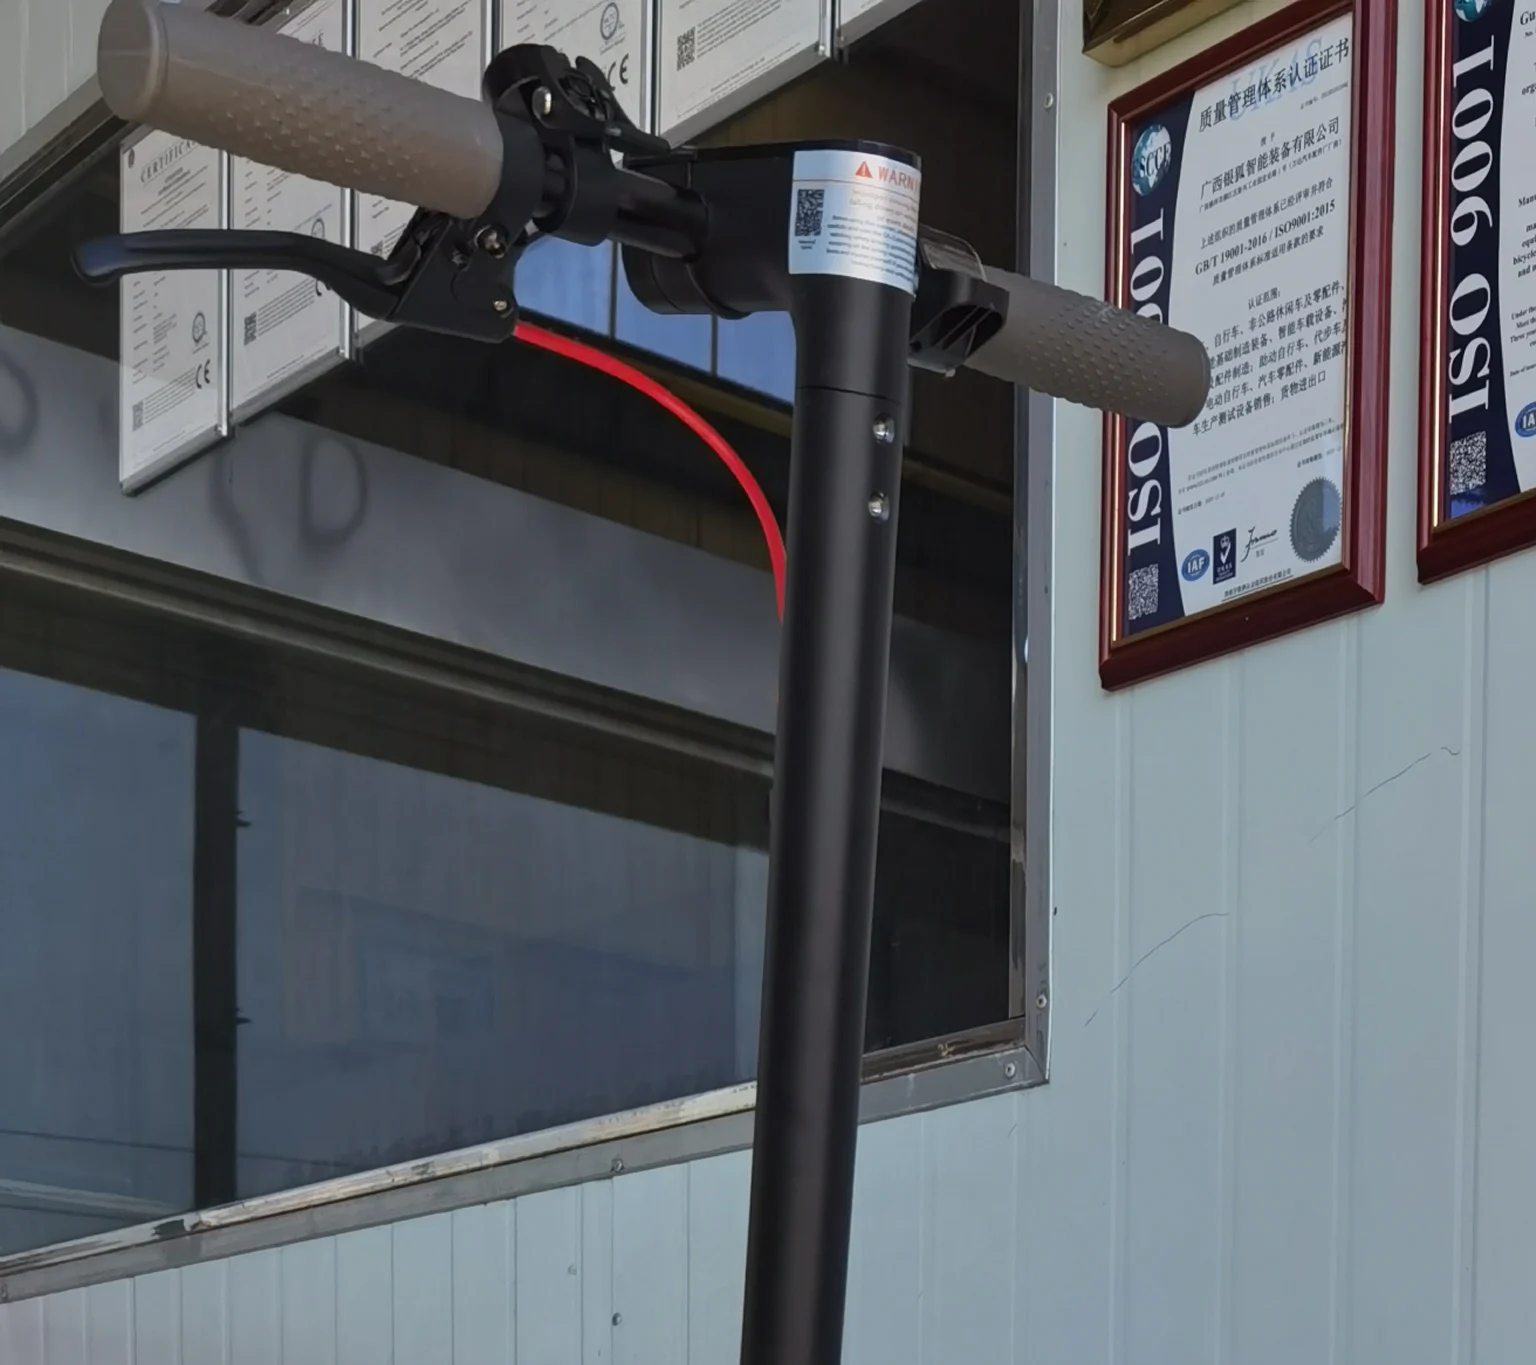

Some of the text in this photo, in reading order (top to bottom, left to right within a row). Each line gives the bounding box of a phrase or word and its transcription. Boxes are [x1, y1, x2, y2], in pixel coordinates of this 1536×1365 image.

[1199, 38, 1349, 132] 质量管理体系认证证书
[141, 140, 196, 183] CERTIFICA
[1200, 117, 1339, 199] 广西银狐智能装备有限公司
[1195, 254, 1219, 275] GB/T
[1221, 231, 1267, 264] 19001-2016
[1274, 199, 1336, 239] ISO9001:2015
[1449, 34, 1494, 424] ISO 9001
[1517, 264, 1531, 277] and
[1128, 421, 1163, 556] ISO
[1187, 557, 1205, 573] IAF
